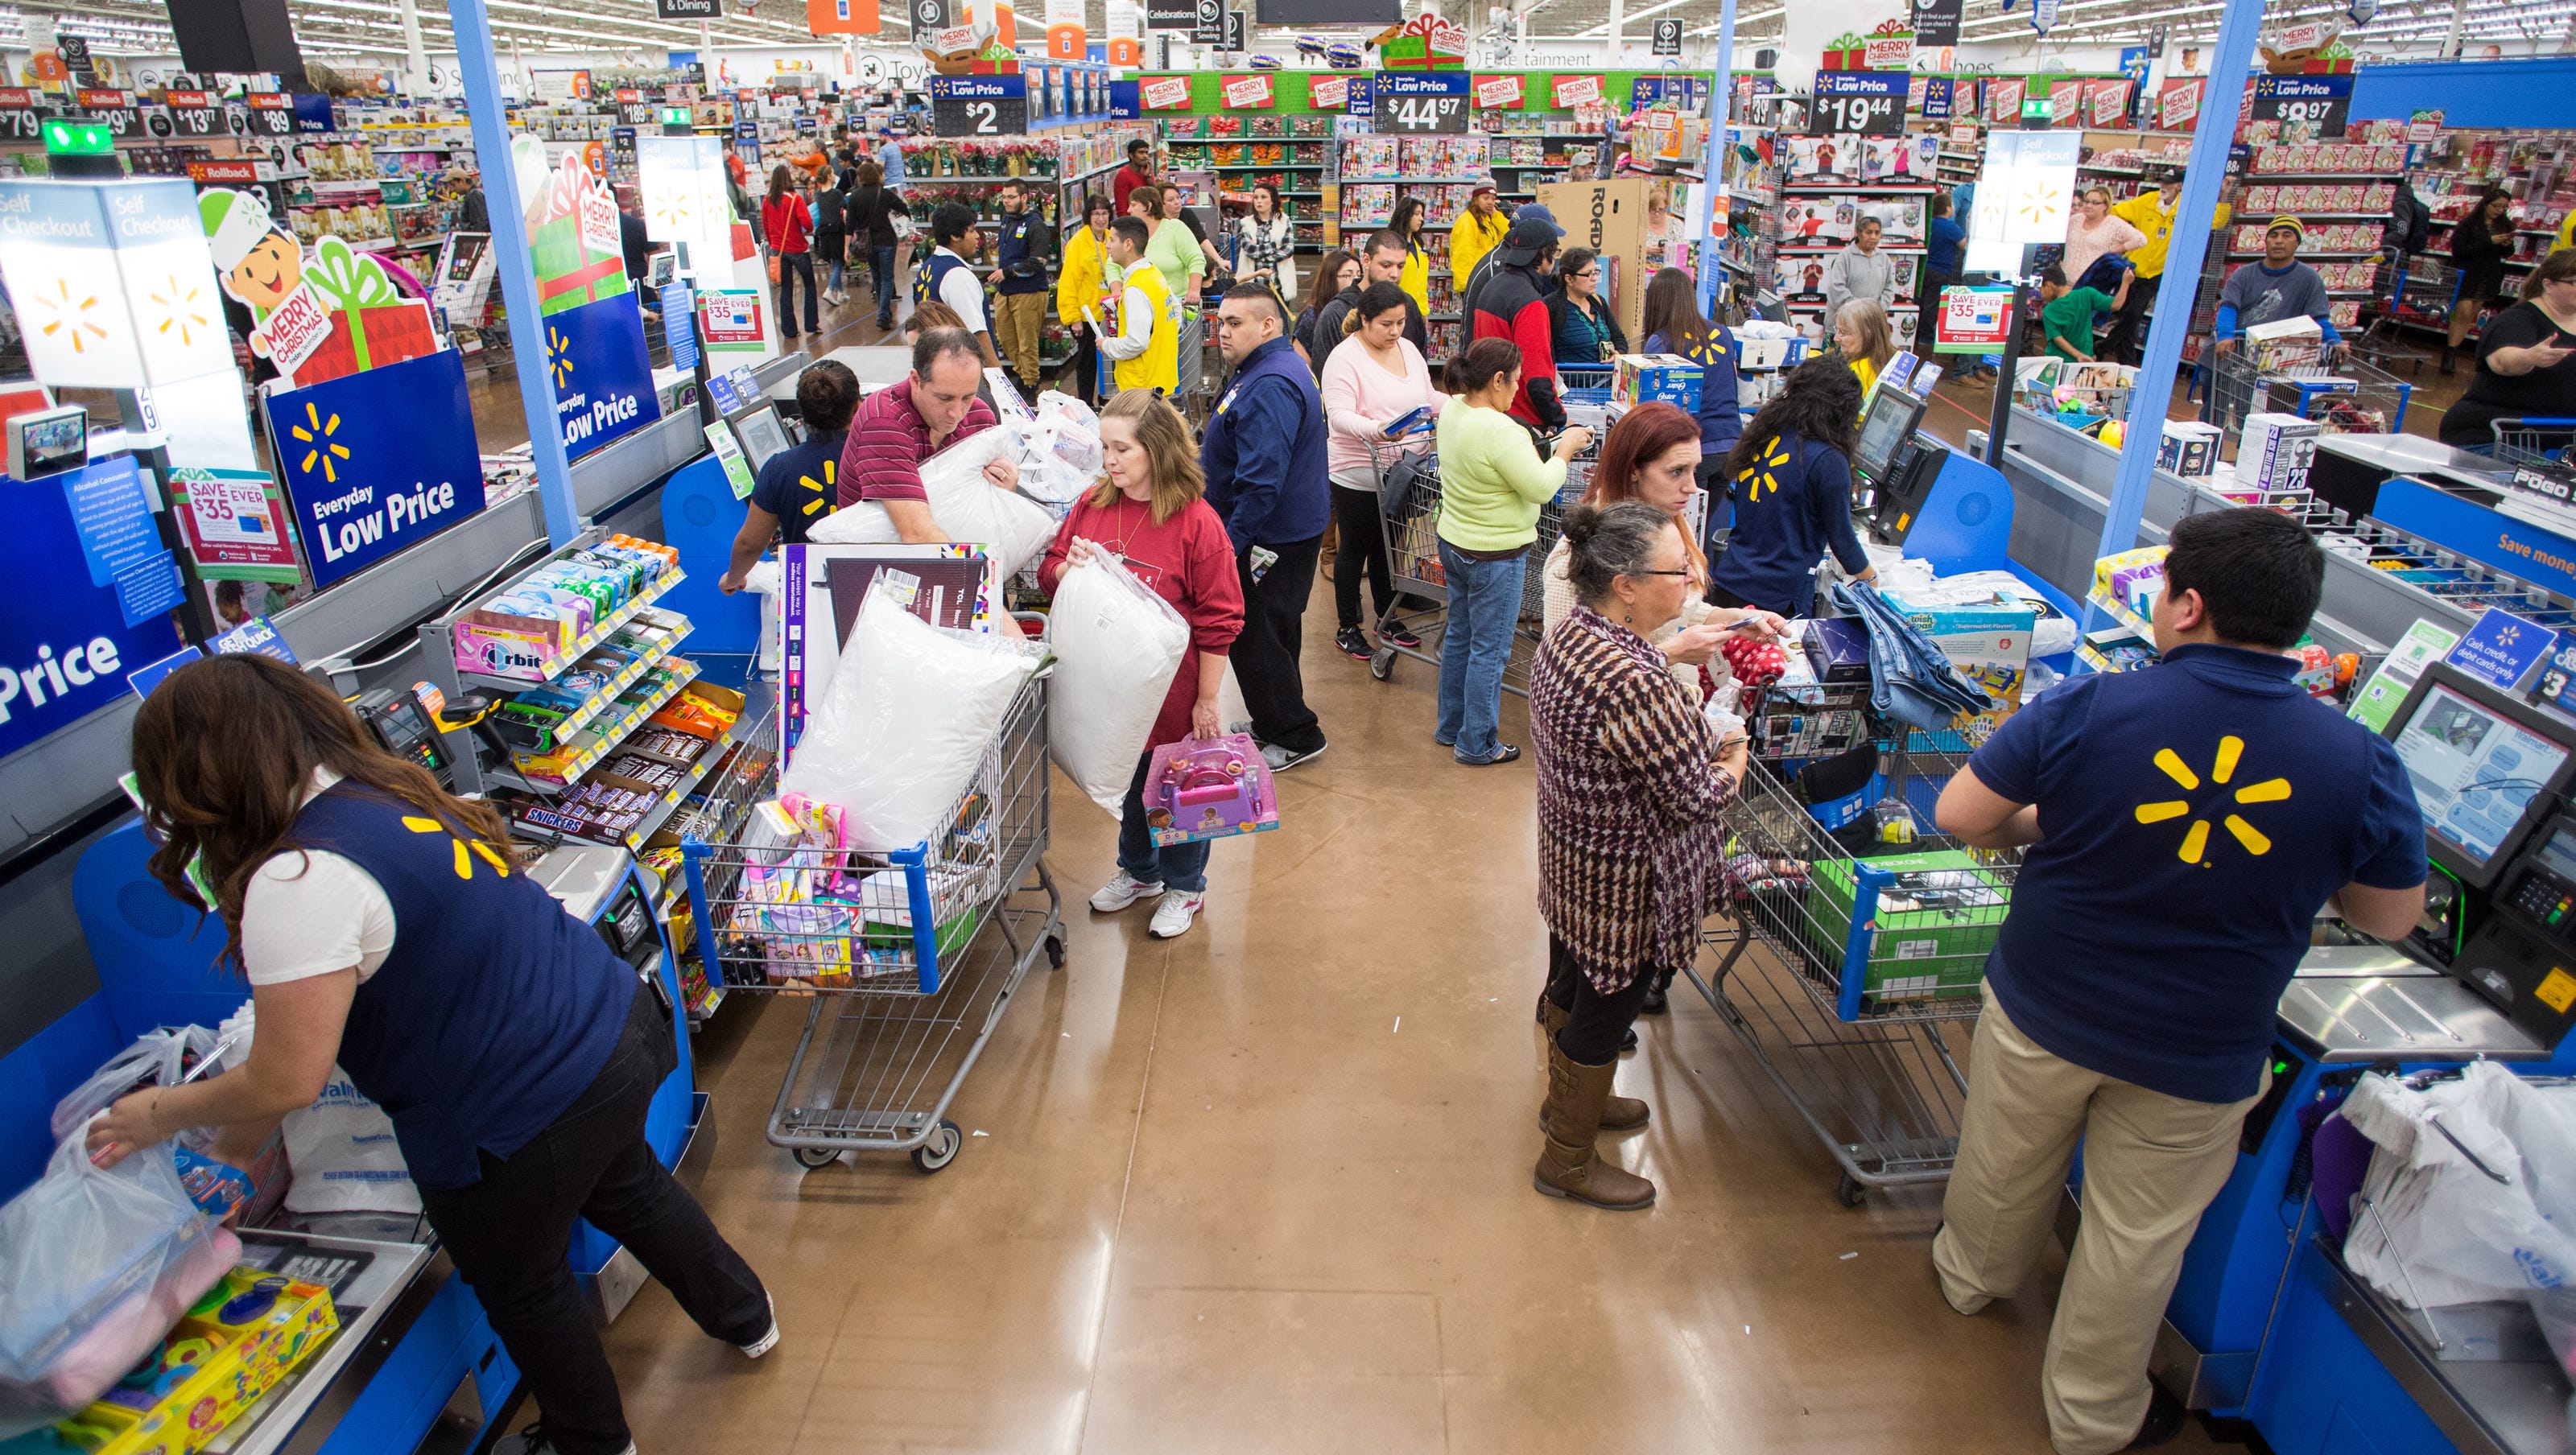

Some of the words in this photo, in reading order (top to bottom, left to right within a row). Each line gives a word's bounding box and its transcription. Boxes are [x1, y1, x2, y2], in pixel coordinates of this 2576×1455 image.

[677, 0, 712, 12] Dining
[1149, 10, 1196, 19] Celebrations
[939, 28, 971, 42] MERRY
[1197, 32, 1220, 40] Sewing
[1434, 32, 1469, 43] MERRY
[2281, 25, 2317, 41] MERRY
[942, 36, 973, 47] CHRISTMAS
[1434, 40, 1466, 51] CHRISTMAS
[1869, 40, 1913, 52] MERRY
[2282, 35, 2316, 47] CHRISTMAS
[1868, 52, 1910, 60] CHRISTMAS
[952, 85, 976, 95] Low
[976, 84, 1004, 95] Price
[1148, 81, 1182, 97] MERRY
[1230, 79, 1263, 97] MERRY
[1395, 81, 1418, 92] Low
[1420, 80, 1447, 92] Price
[1480, 81, 1514, 94] MERRY
[1559, 80, 1594, 94] MERRY
[1835, 81, 1858, 92] Low
[1860, 80, 1888, 92] Price
[2277, 84, 2301, 95] Low
[2302, 84, 2330, 95] Price
[0, 93, 27, 104] ollback
[92, 95, 122, 105] Rollback
[178, 94, 204, 105] Rollback
[1150, 90, 1183, 103] CHRISTMAS
[1232, 88, 1265, 101] CHRISTMAS
[1482, 89, 1517, 101] CHRISTMAS
[1561, 89, 1596, 101] CHRISTMAS
[1998, 89, 2020, 105] MERRY
[2095, 89, 2124, 108] MERRY
[2164, 88, 2198, 108] MERRY
[625, 104, 646, 124] $189
[1111, 107, 1129, 116] rice
[1351, 105, 1370, 114] Low
[1927, 105, 1946, 114] Low
[2096, 99, 2122, 117] CHRISTMAS
[2164, 99, 2198, 117] CHRISTMAS
[0, 110, 39, 137] $79
[263, 110, 290, 134] $89
[966, 102, 997, 133] $2
[300, 120, 324, 130] Price
[2023, 138, 2043, 149] Self
[2023, 150, 2070, 161] Checkout
[207, 167, 251, 179] Rollback
[0, 193, 32, 213] Self
[116, 195, 145, 216] Self
[583, 201, 617, 229] MERRY
[3, 215, 95, 238] Checkout
[122, 216, 193, 237] Checkout
[584, 223, 618, 242] CHRISTMAS
[708, 298, 729, 306] SAVE
[1952, 295, 1975, 303] SAVE
[709, 307, 731, 318] $35
[1951, 304, 1975, 317] $35
[262, 288, 312, 352] MERRY
[277, 310, 323, 363] CHRISTMAS
[557, 393, 585, 414] veryday
[1657, 392, 1677, 401] Oster
[564, 413, 592, 447] ow
[592, 393, 638, 431] Price
[73, 478, 99, 493] Alcohol
[99, 471, 133, 486] Consumer:
[2287, 468, 2309, 489] 23
[2513, 471, 2569, 498] POGO
[191, 483, 228, 497] SAVE
[231, 490, 264, 503] EVER
[194, 499, 233, 520] $35
[312, 485, 373, 520] Everyday
[318, 509, 383, 563] Low
[386, 481, 455, 534] Price
[2498, 534, 2531, 558] Save
[2533, 549, 2576, 579] mone
[956, 588, 964, 605] TCL
[1910, 614, 1933, 624] wish
[2466, 637, 2484, 652] Cash,
[2484, 646, 2508, 664] credit,
[2508, 657, 2519, 666] or
[2457, 648, 2479, 663] debit
[2476, 657, 2496, 672] cards
[2496, 666, 2515, 680] only.
[0, 636, 122, 723] Price
[2543, 671, 2567, 697] $3
[2515, 728, 2551, 752] Walmart
[527, 808, 581, 832] SNICKERS
[604, 827, 613, 835] 48
[323, 1171, 337, 1180] PLEASE
[338, 1171, 354, 1180] RETURN
